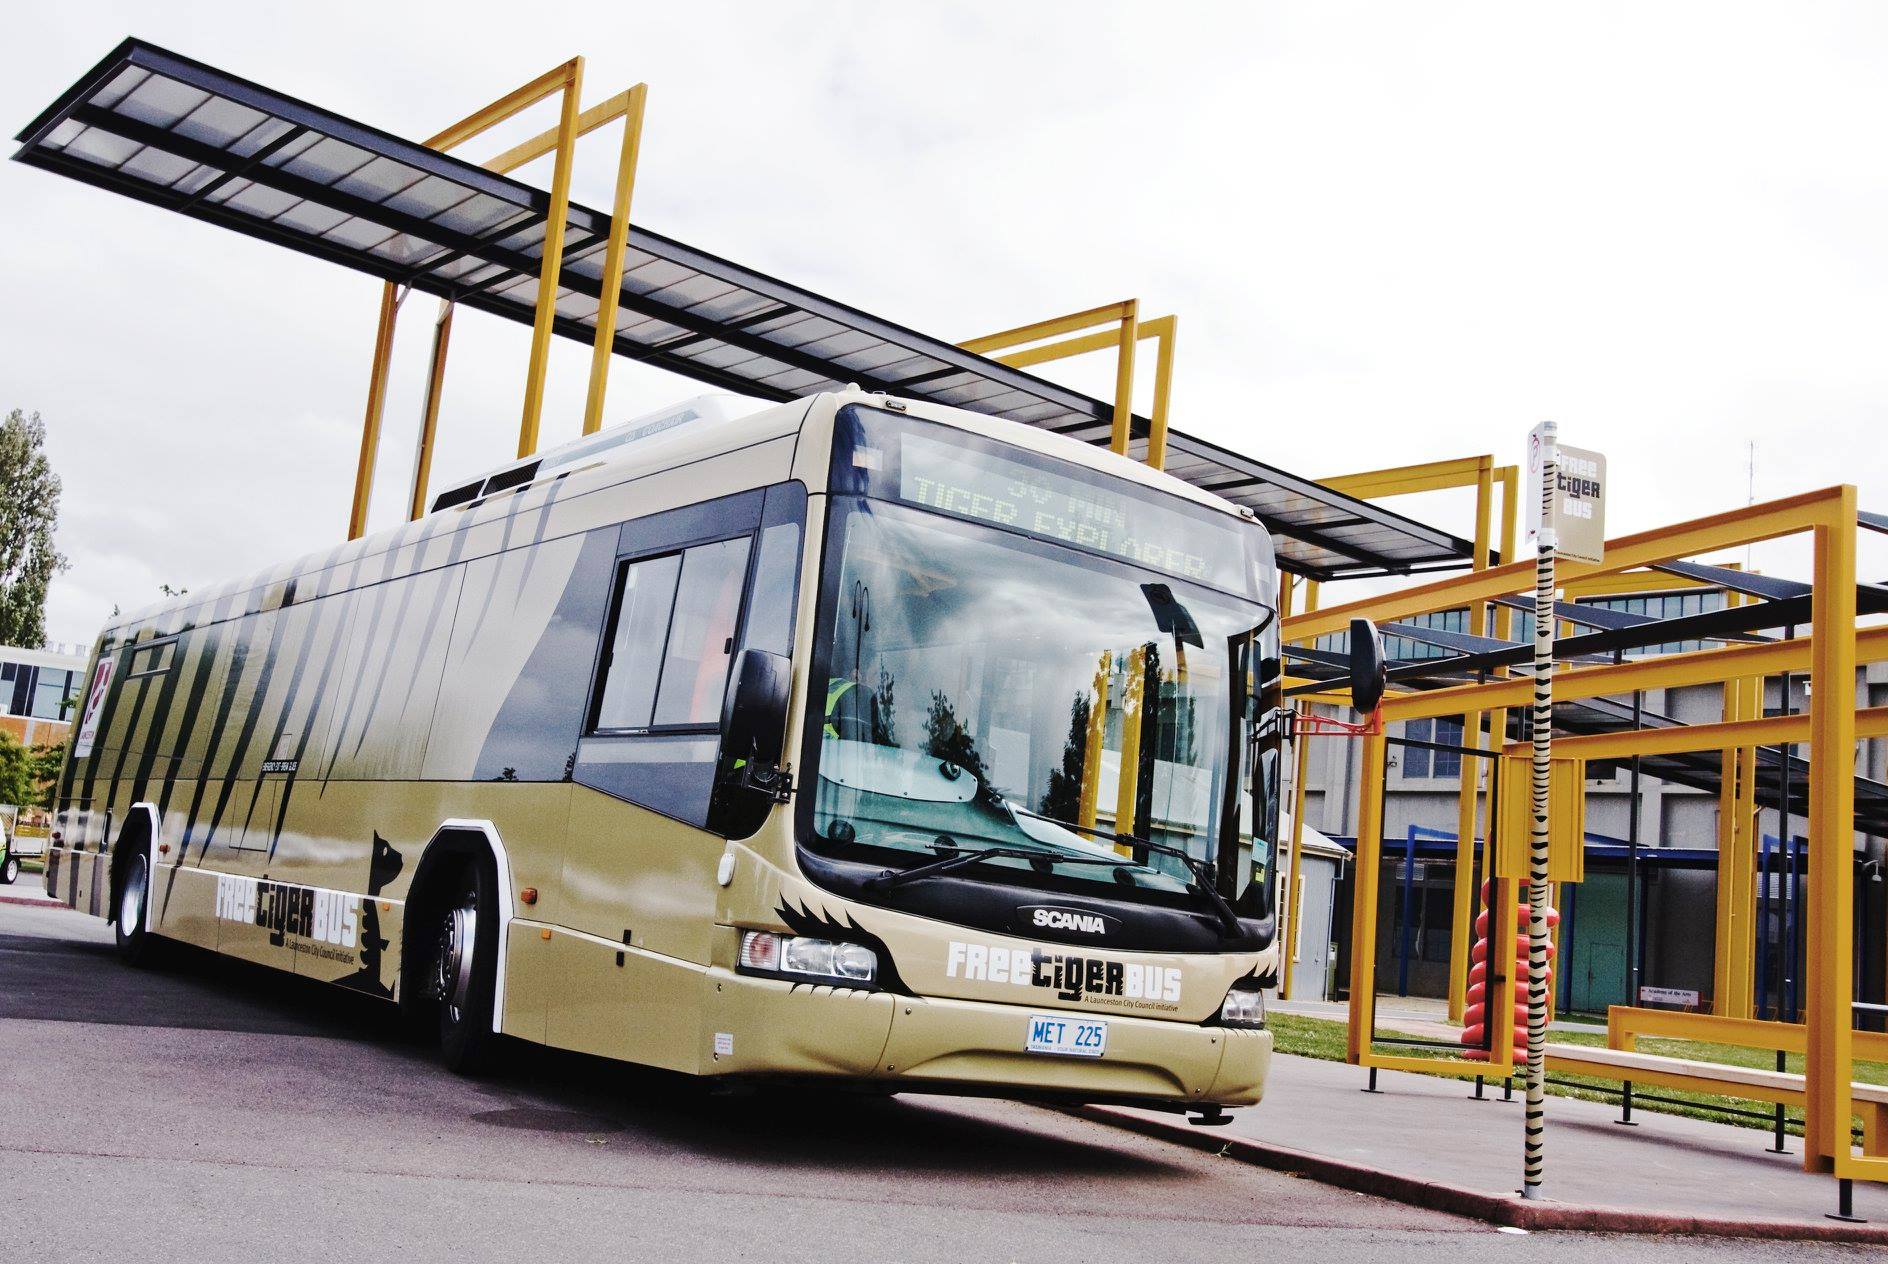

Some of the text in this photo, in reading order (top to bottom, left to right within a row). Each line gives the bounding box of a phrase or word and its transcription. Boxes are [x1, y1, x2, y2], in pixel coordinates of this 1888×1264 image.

[914, 476, 1018, 526] TIGER
[1033, 909, 1106, 934] SCANIA
[1125, 963, 1182, 1002] BUS
[1090, 996, 1122, 1006] Launceston
[1123, 1000, 1134, 1008] City
[1135, 1001, 1155, 1009] Council
[1156, 1002, 1179, 1012] initiative
[1033, 1021, 1102, 1047] MET 225
